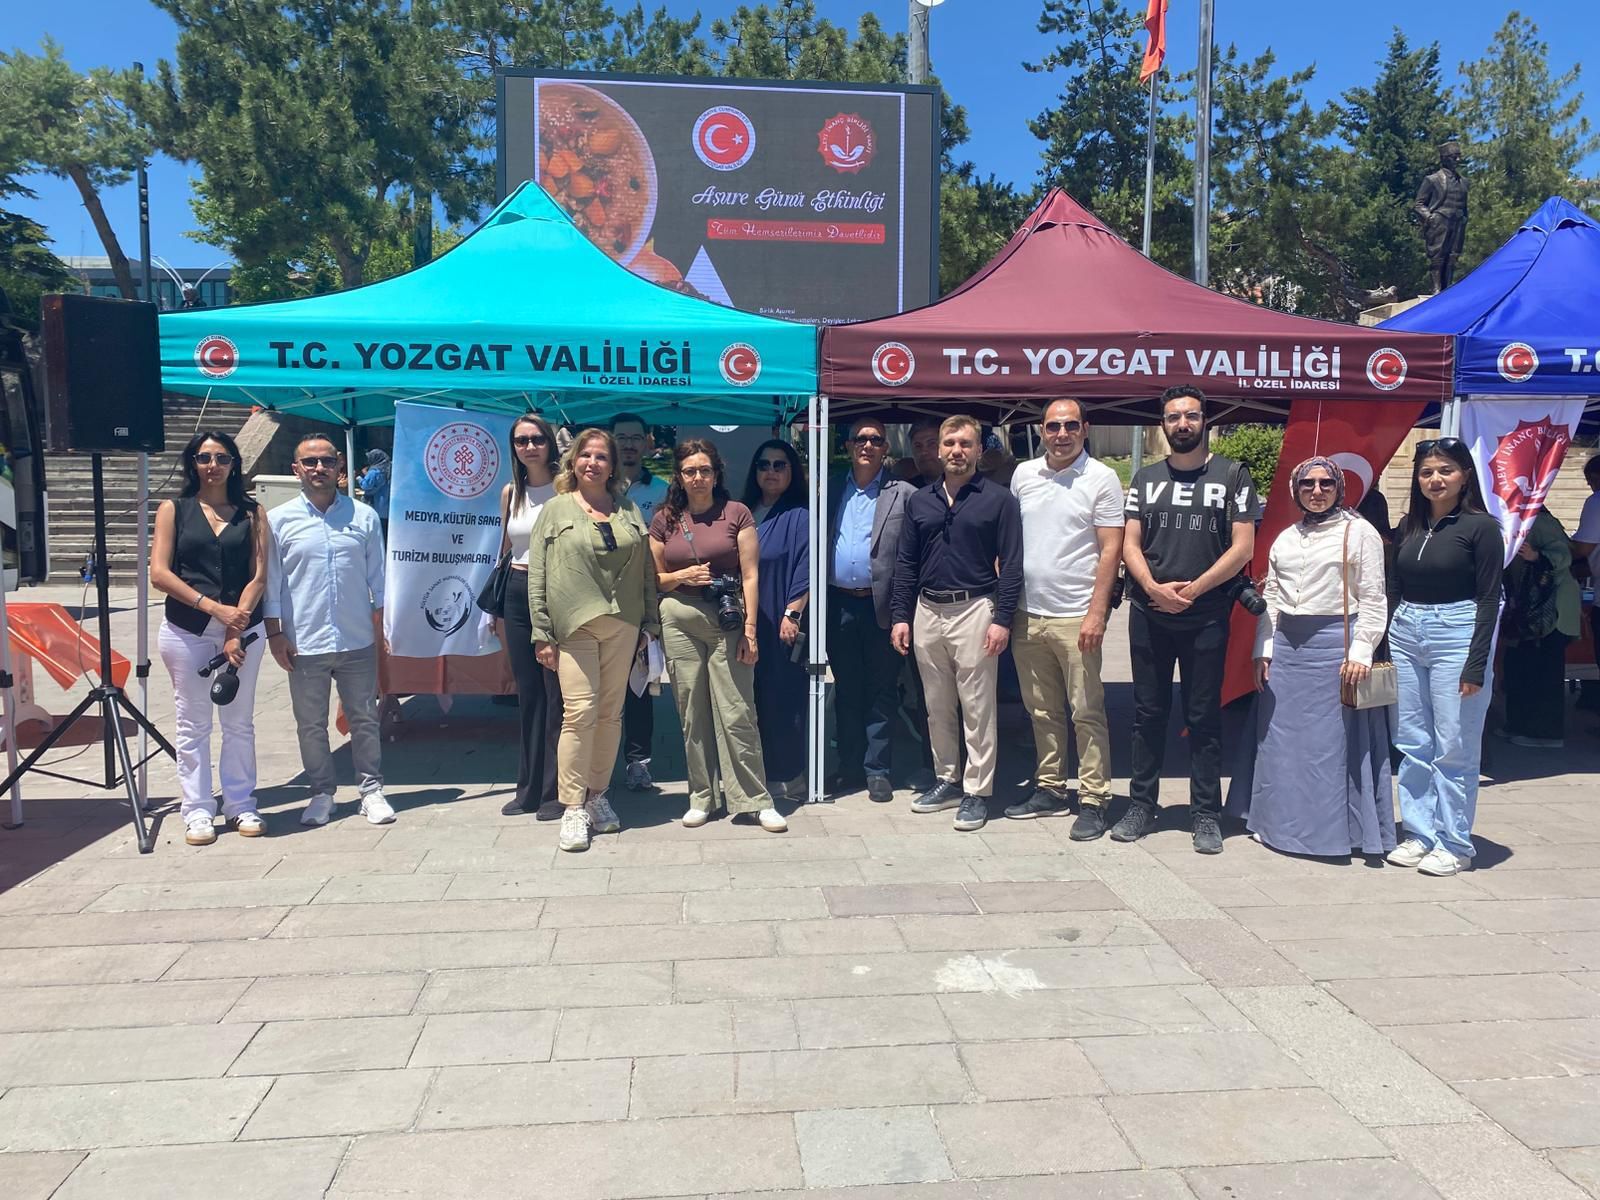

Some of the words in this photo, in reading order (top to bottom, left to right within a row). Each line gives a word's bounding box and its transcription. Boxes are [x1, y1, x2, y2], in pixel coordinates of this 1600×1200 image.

[691, 185, 749, 207] Aşure
[754, 187, 806, 211] Günü
[810, 189, 886, 213] Etkinliği
[269, 341, 340, 369] T.C.
[353, 342, 512, 371] YOZGAT
[525, 339, 691, 374] VALİLİĞİ
[943, 348, 1010, 375] T.C.
[1022, 348, 1174, 376] YOZGAT
[1185, 345, 1341, 378] VALİLİĞİ
[1564, 348, 1600, 373] T.
[582, 374, 596, 385] İL
[599, 374, 634, 386] ÖZEL
[638, 375, 691, 386] İDARESİ
[1238, 377, 1250, 388] İL
[1254, 378, 1286, 389] ÖZEL
[1290, 379, 1340, 390] İDARESİ
[1500, 428, 1534, 456] İNANÇ
[1124, 481, 1249, 513] EVERY
[1145, 511, 1219, 533] THING
[451, 533, 464, 545] VE
[392, 549, 429, 562] TURİZM
[432, 552, 491, 566] BULUŞMALARI
